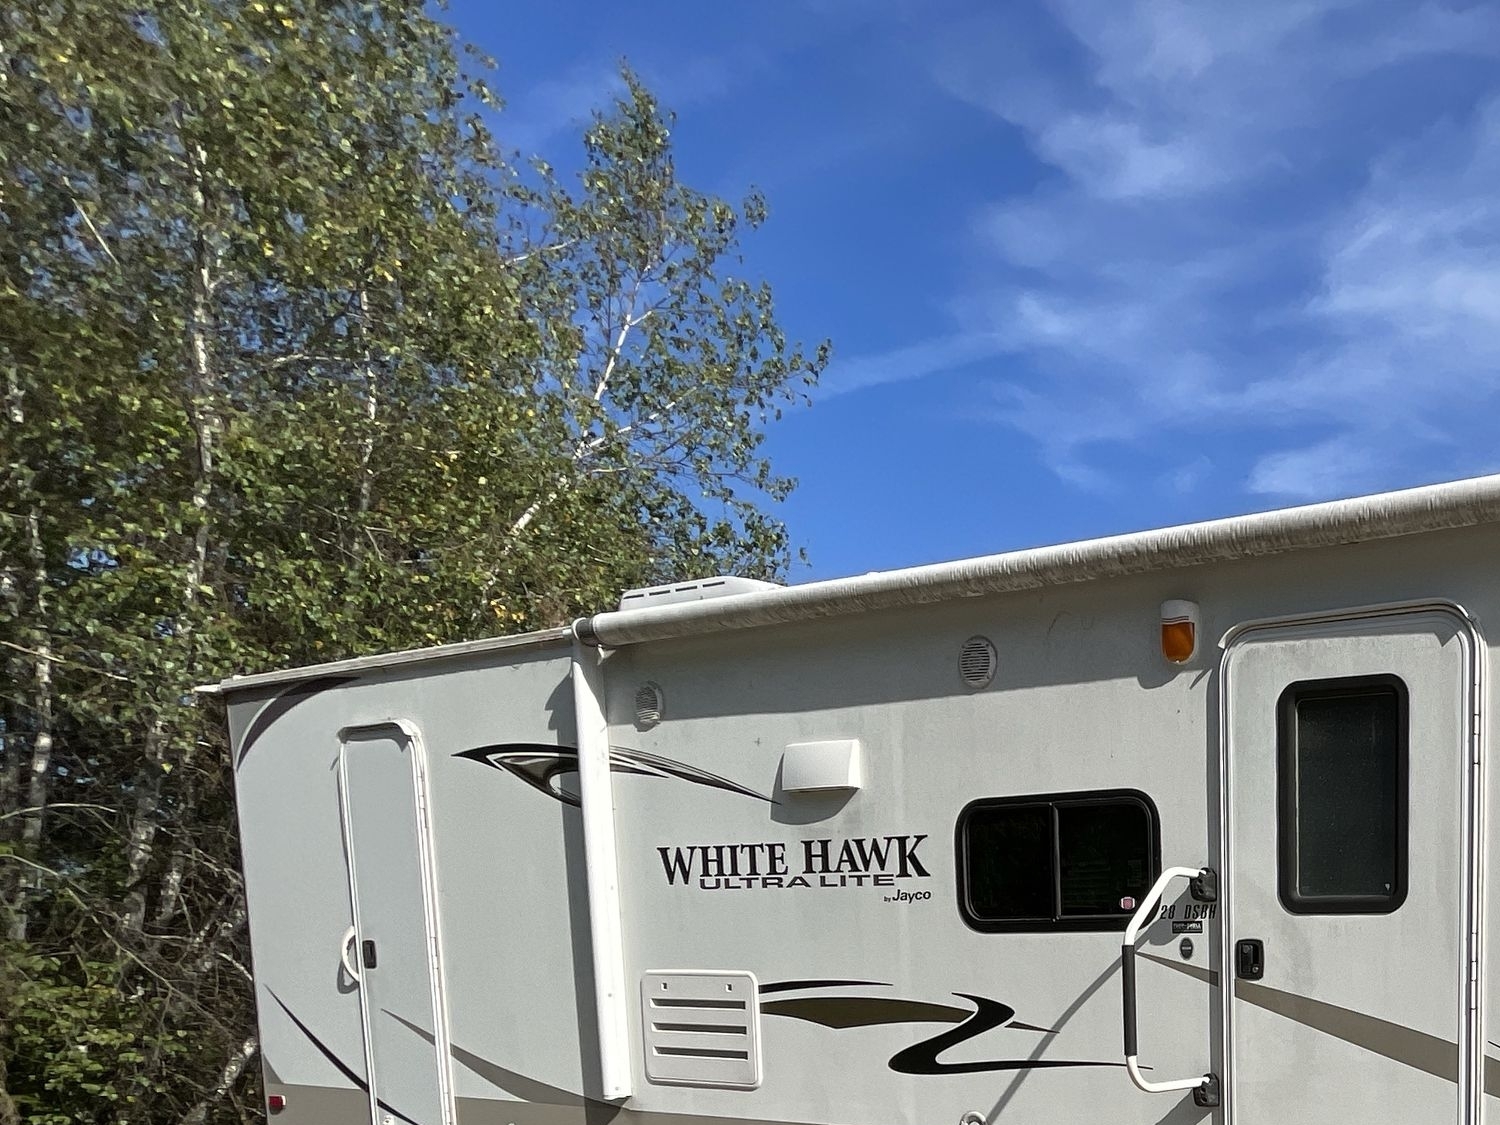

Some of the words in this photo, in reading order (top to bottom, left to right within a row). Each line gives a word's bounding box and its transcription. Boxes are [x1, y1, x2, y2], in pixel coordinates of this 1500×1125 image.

[656, 842, 789, 886] WHITE
[801, 834, 931, 878] HAWK
[699, 876, 812, 890] ULTRA
[820, 873, 895, 888] LITE
[884, 895, 892, 903] by
[892, 889, 932, 904] Jayco
[1160, 904, 1176, 920] 28
[1184, 903, 1217, 920] DSBH
